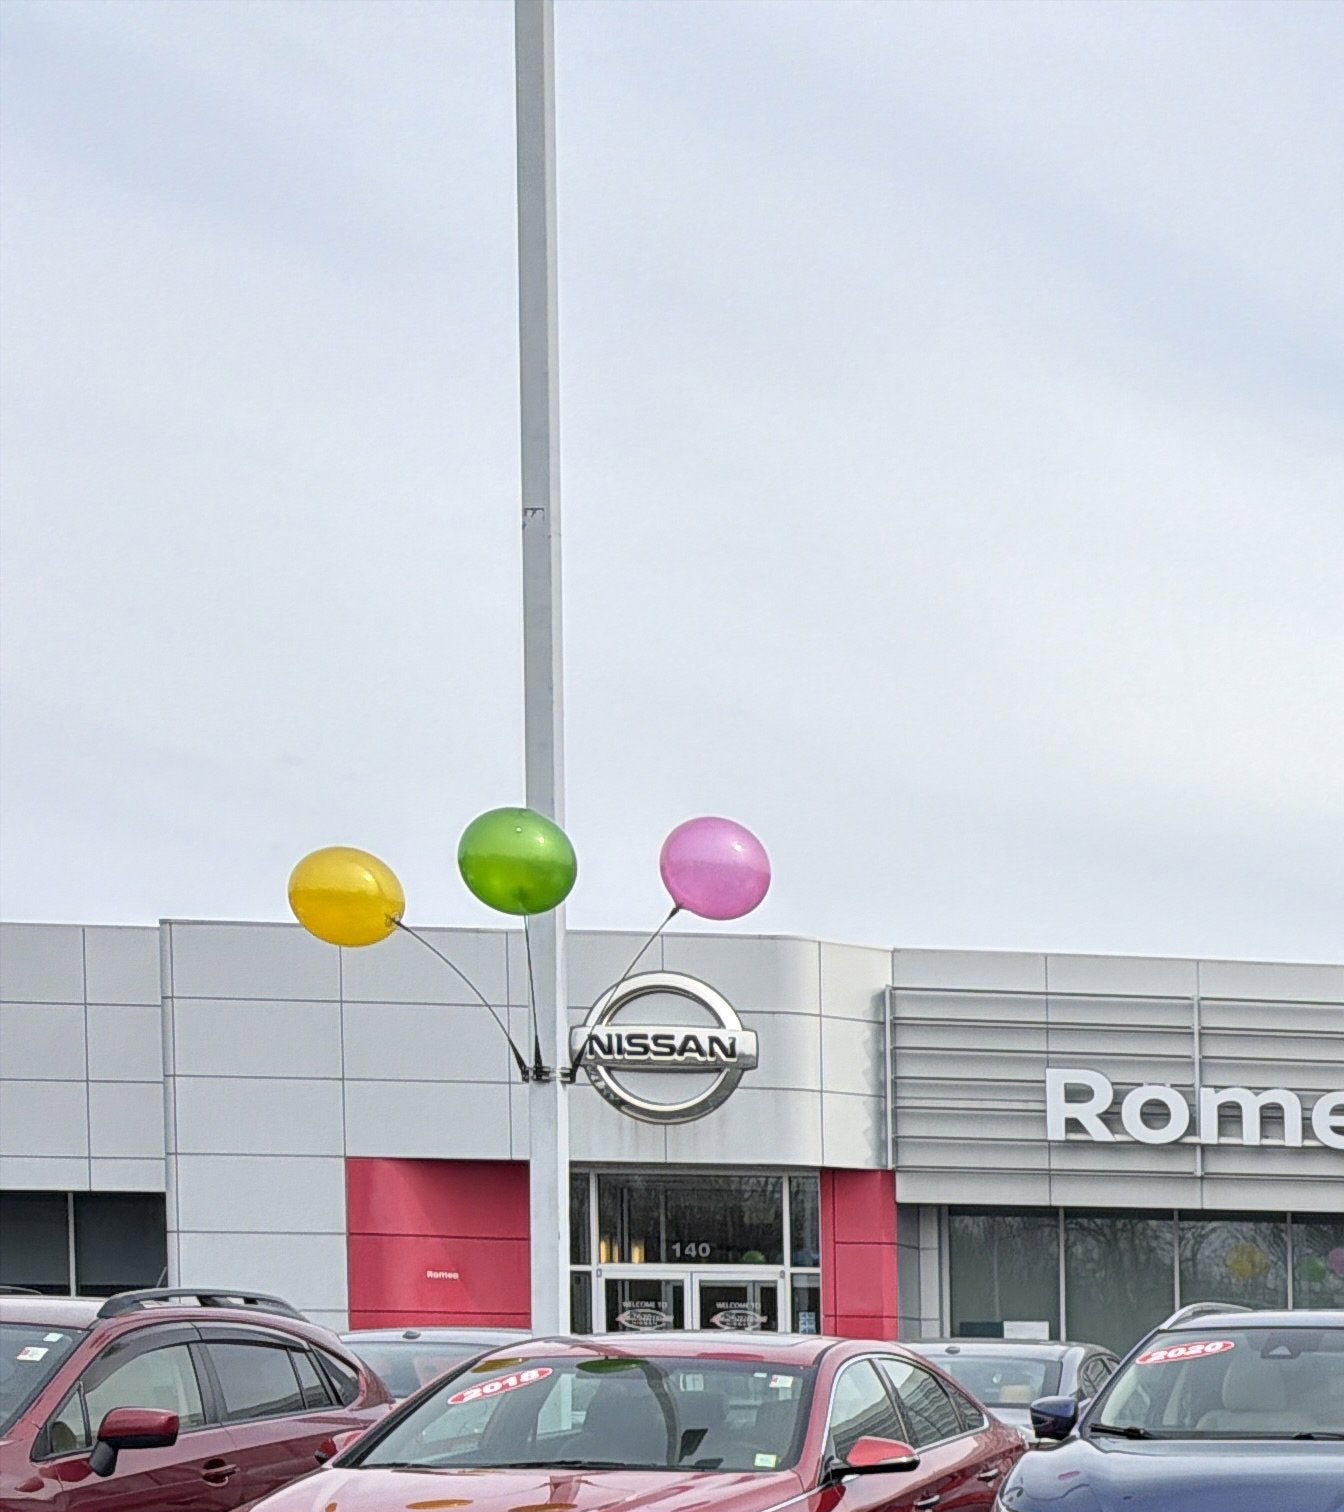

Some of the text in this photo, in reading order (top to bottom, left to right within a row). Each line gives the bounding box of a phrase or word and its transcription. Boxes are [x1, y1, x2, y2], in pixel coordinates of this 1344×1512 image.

[586, 1032, 738, 1061] NISSAN
[671, 1242, 711, 1258] 140
[426, 1270, 460, 1280] Romeo
[1151, 1341, 1224, 1361] 2020
[463, 1371, 540, 1400] 2018
